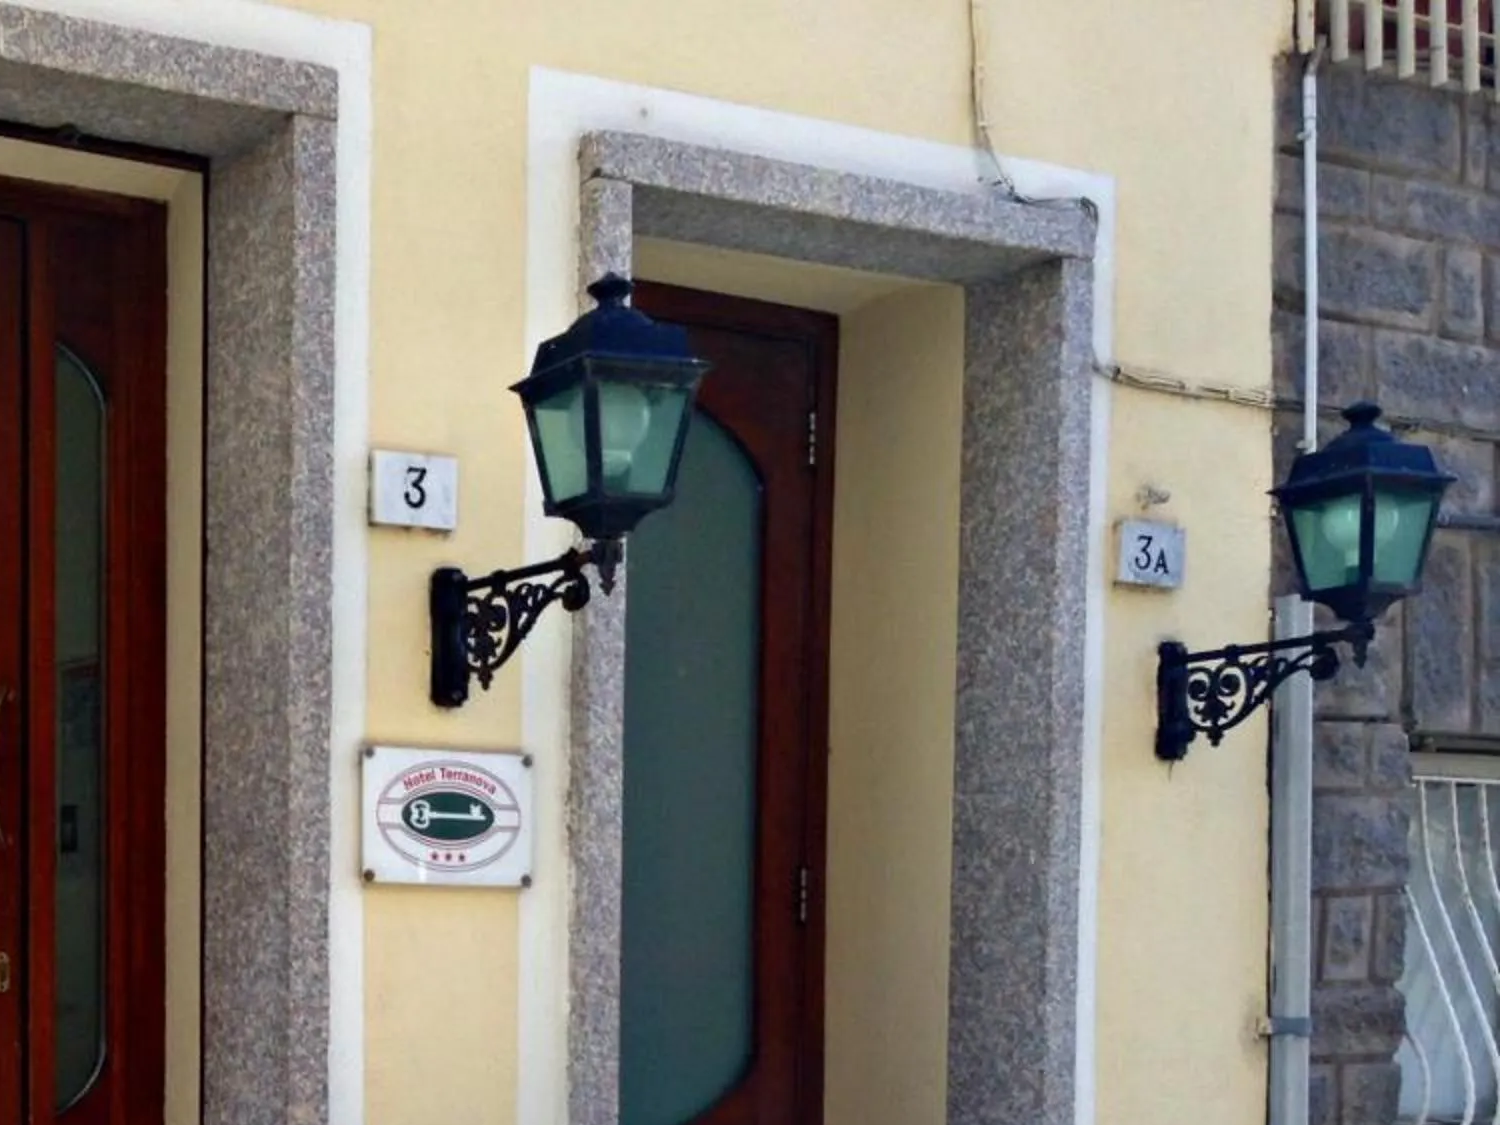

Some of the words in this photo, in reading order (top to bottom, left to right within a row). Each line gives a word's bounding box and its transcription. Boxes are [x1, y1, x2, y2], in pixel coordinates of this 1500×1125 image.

[404, 465, 427, 509] 3
[1134, 535, 1169, 574] 3A
[403, 767, 435, 790] Hotel
[440, 767, 497, 795] Terranova
